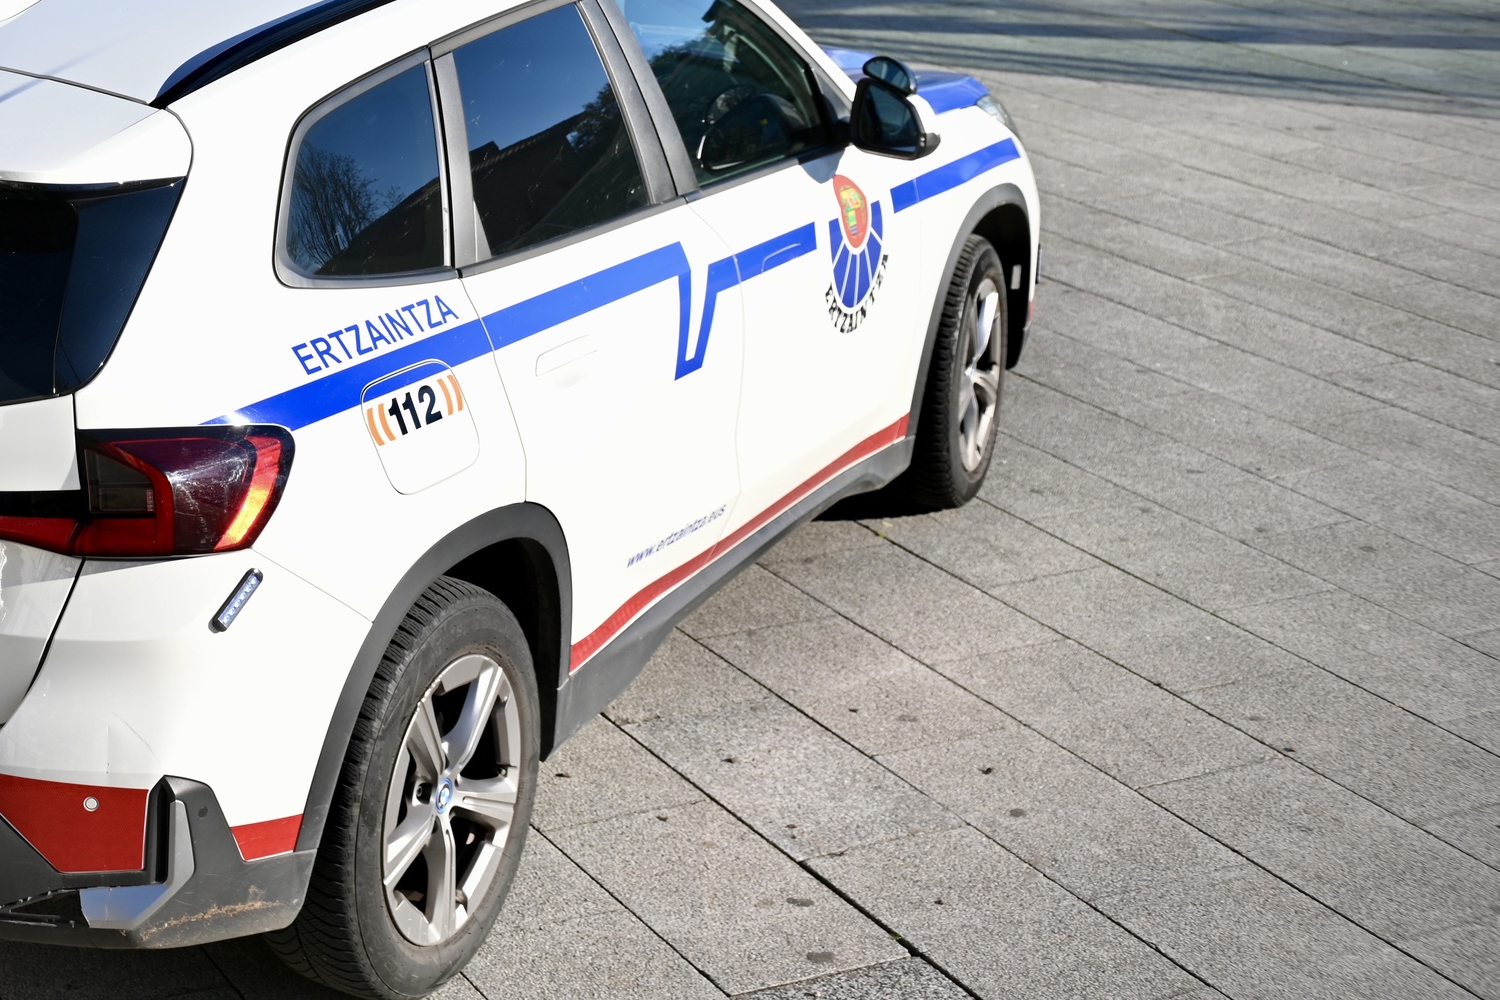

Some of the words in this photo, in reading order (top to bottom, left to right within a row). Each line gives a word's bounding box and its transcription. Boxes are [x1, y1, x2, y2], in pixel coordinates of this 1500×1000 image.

[291, 295, 460, 376] ERTZAINTZA
[388, 384, 443, 436] 112
[626, 504, 727, 569] www.ertzaintza.eus
